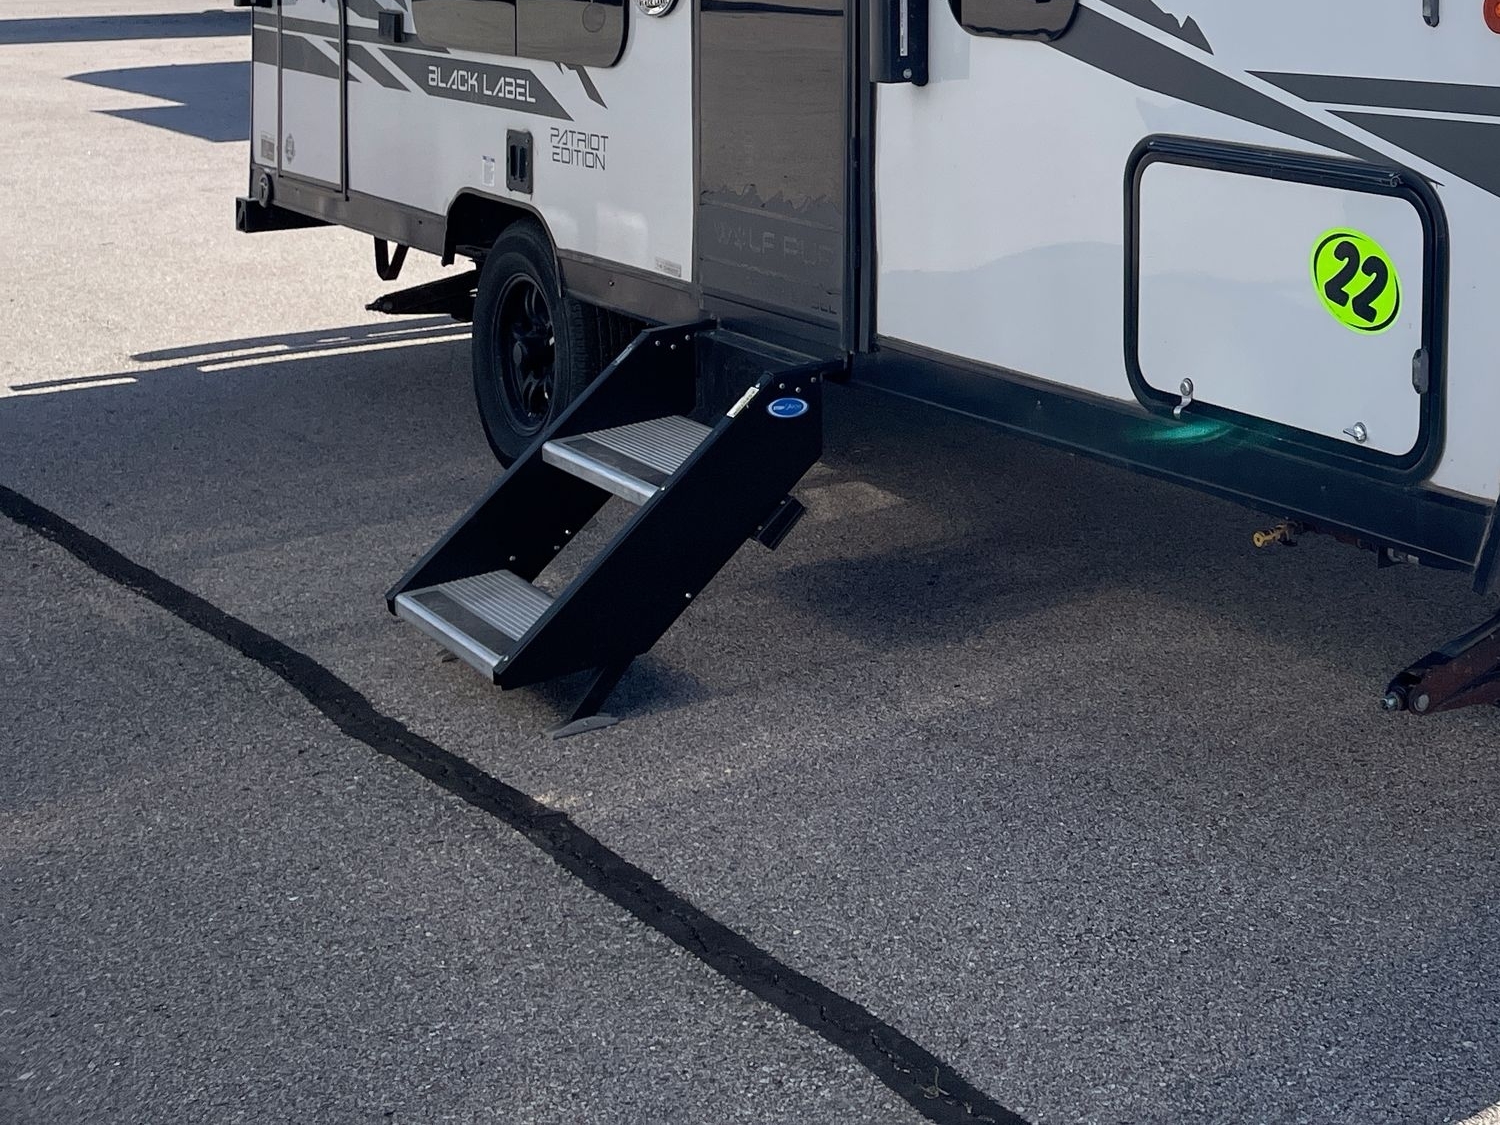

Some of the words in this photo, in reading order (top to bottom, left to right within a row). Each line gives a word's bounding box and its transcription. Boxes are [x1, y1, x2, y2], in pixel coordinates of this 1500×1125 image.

[428, 65, 478, 93] BLACK
[483, 74, 536, 103] LABEL
[550, 127, 609, 152] PATRIOT
[552, 146, 606, 171] EDITION
[1324, 241, 1389, 323] 22
